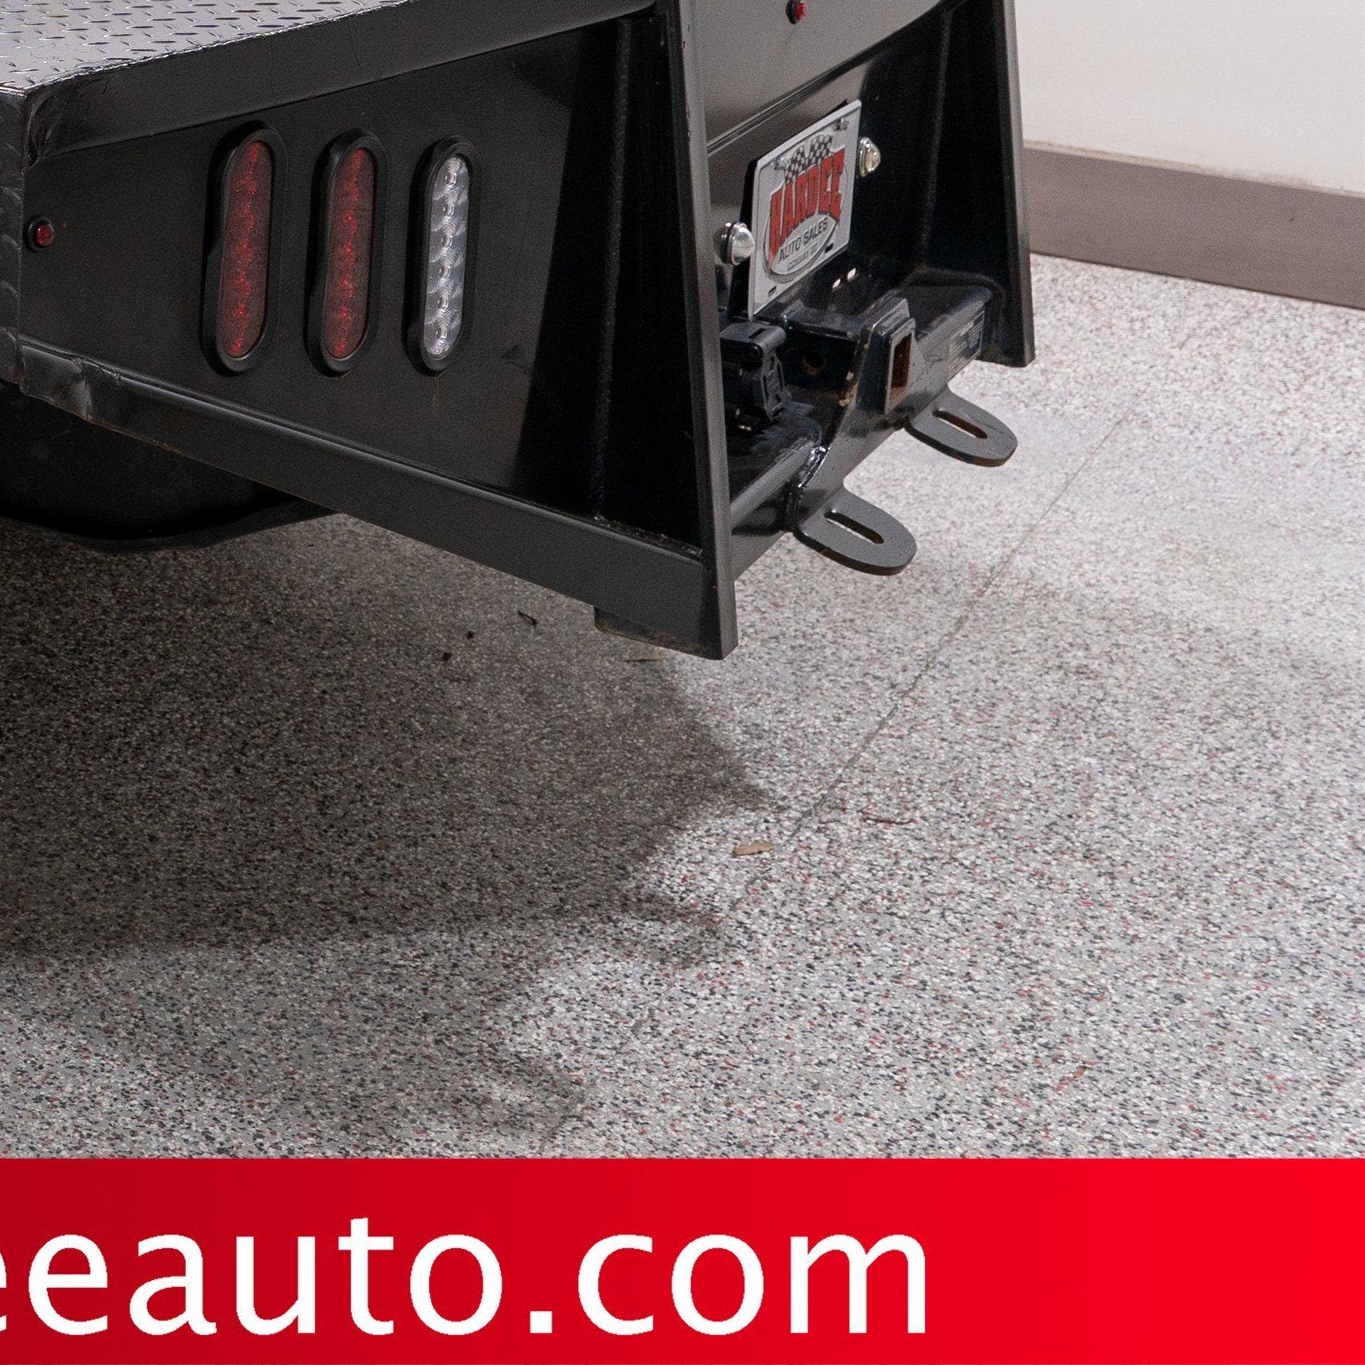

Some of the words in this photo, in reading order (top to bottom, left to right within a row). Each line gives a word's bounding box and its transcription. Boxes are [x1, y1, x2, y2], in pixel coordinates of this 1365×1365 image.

[769, 146, 847, 269] HARDEE
[779, 236, 802, 263] AUTO
[803, 217, 829, 245] SALES
